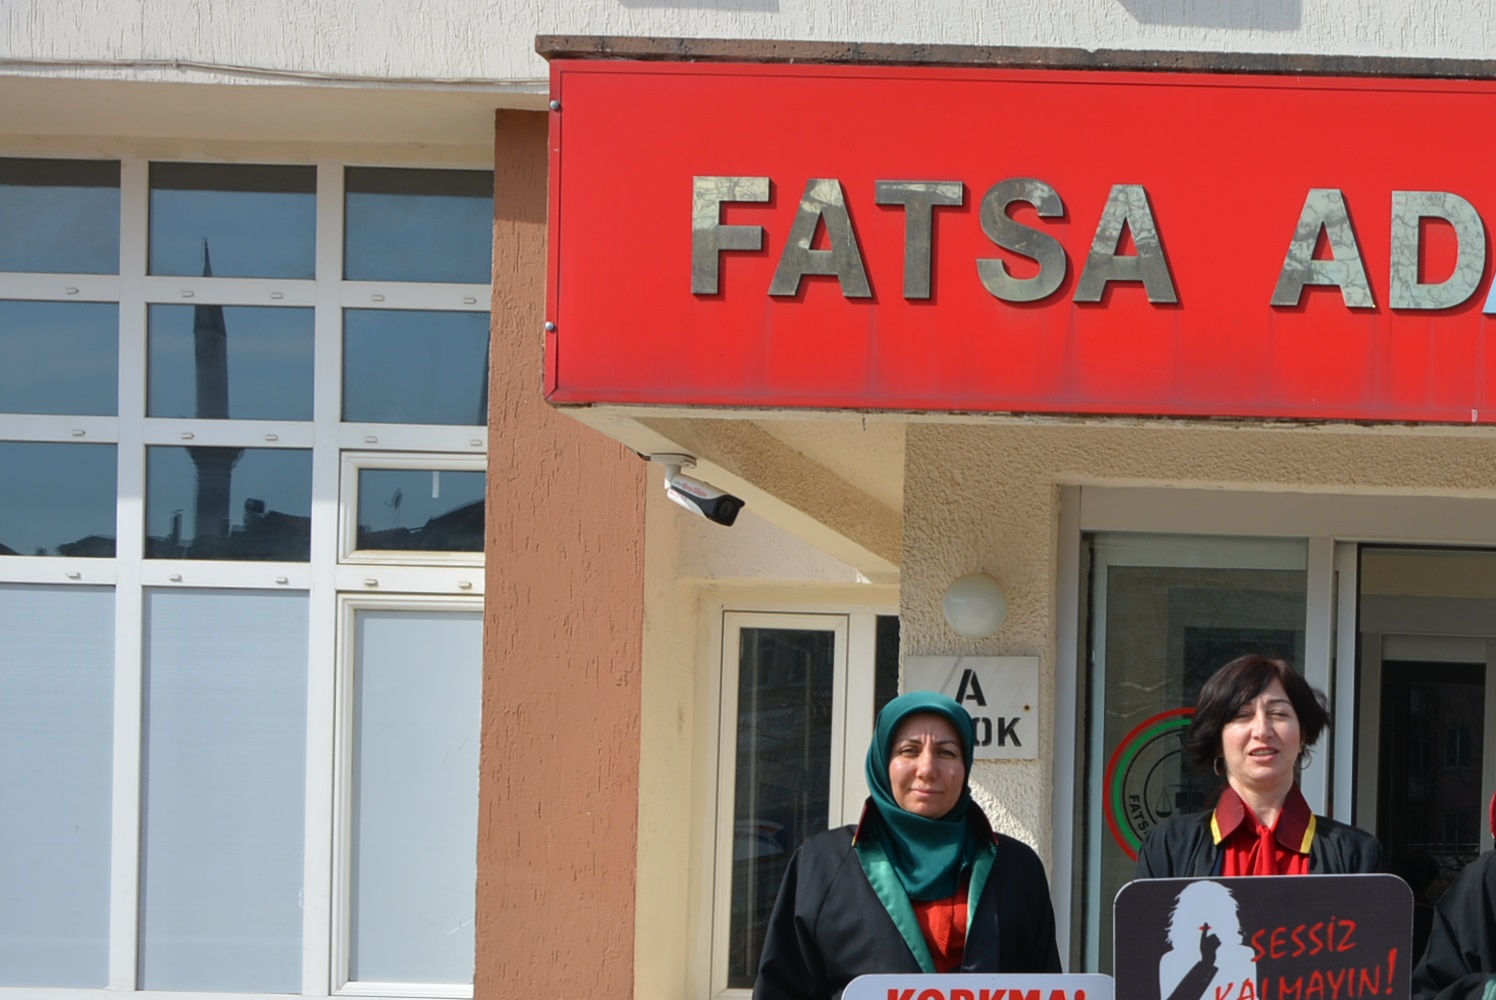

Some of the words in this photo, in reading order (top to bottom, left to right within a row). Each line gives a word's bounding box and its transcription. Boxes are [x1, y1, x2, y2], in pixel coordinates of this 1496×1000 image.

[690, 175, 1178, 304] FATSA
[954, 668, 988, 707] A
[972, 716, 1023, 748] OK
[1128, 794, 1150, 835] FATS
[1250, 914, 1358, 963] SESSİZ
